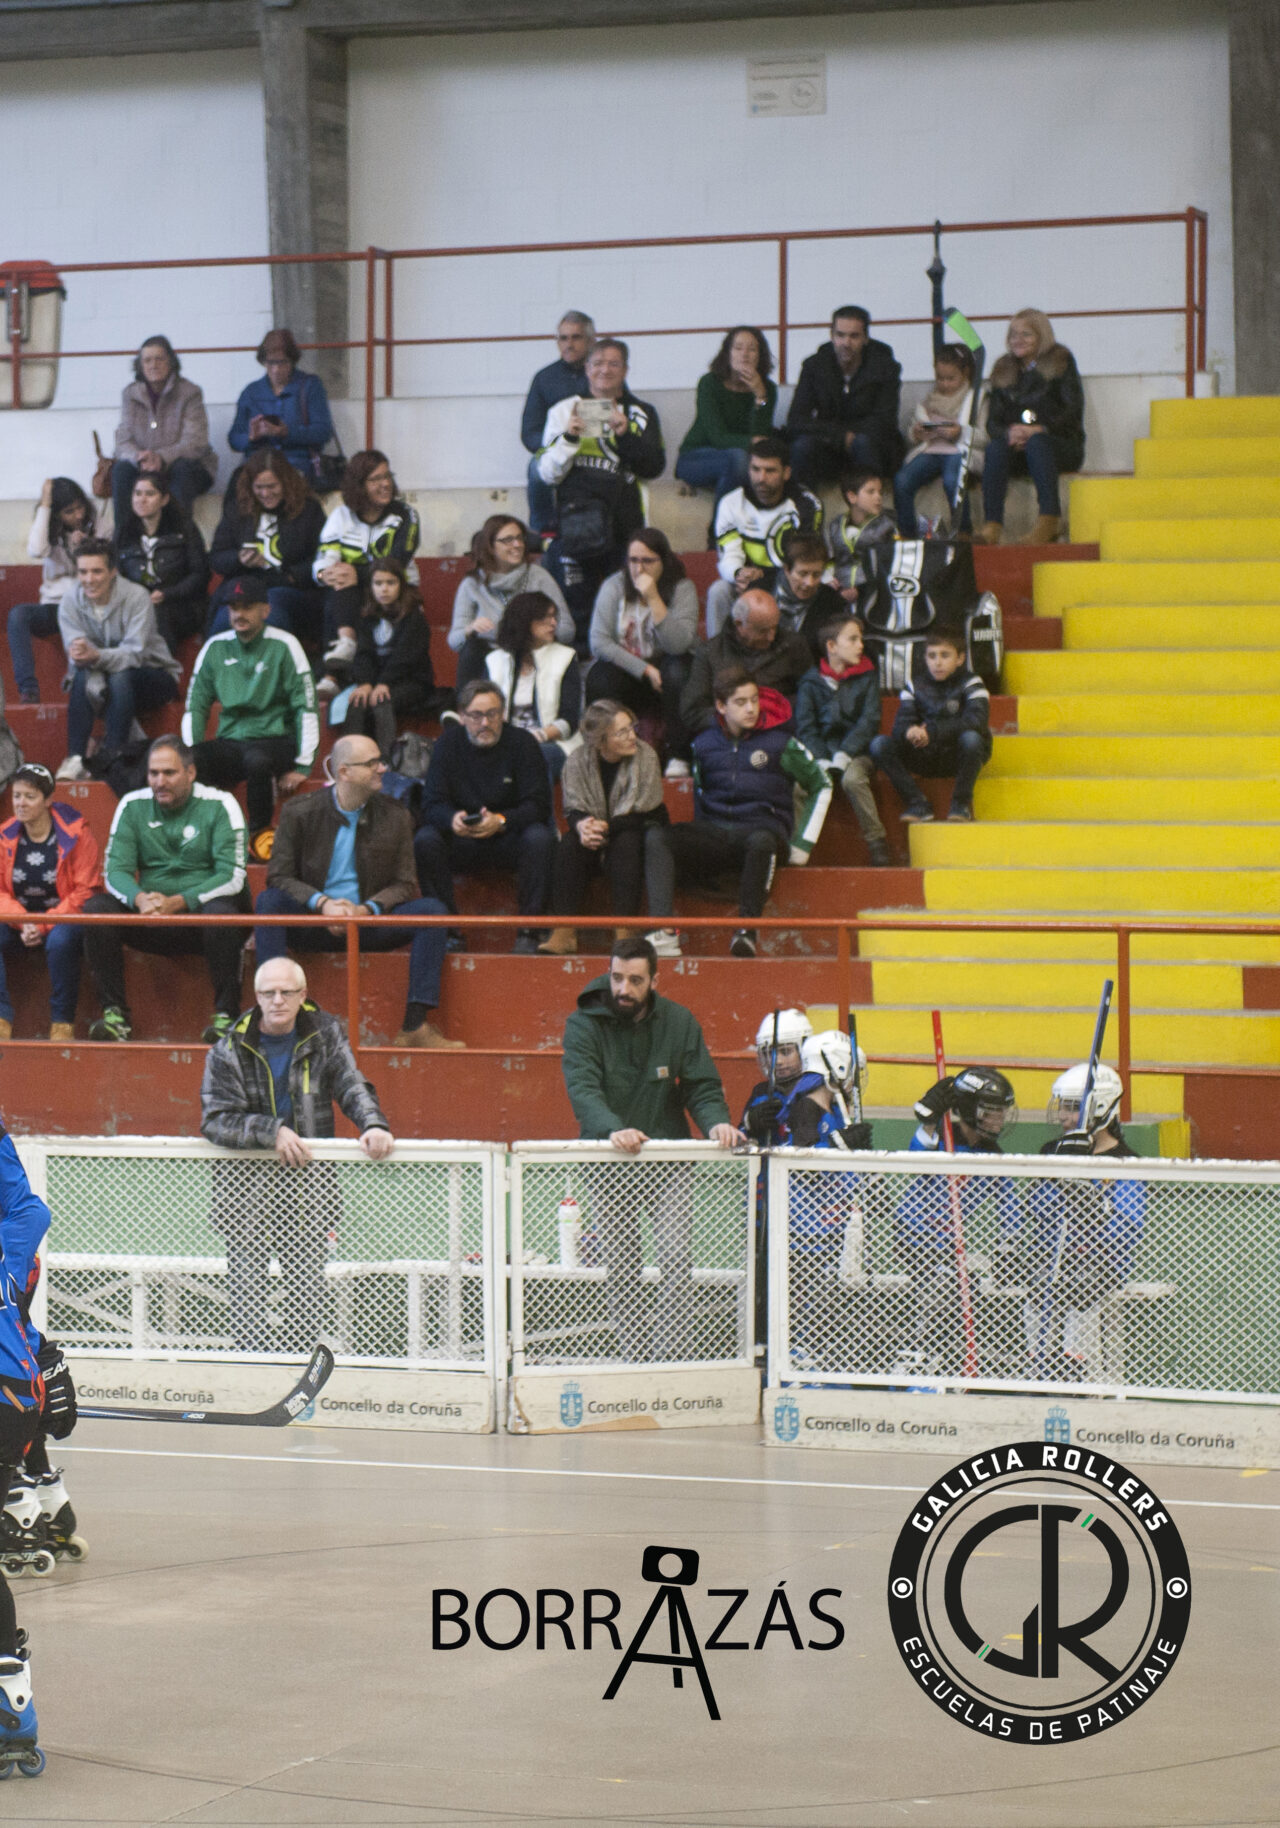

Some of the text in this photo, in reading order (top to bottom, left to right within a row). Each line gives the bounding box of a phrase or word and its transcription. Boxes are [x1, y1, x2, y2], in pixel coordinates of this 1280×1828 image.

[68, 786, 90, 799] 49
[673, 957, 699, 976] 42
[77, 1385, 215, 1404] Concello da Coruña
[587, 1394, 723, 1414] Concello da Coruña
[320, 1397, 382, 1413] Concello
[387, 1399, 404, 1414] da
[410, 1401, 462, 1417] Coruña
[804, 1416, 957, 1437] Concello da Coruña
[1075, 1428, 1235, 1449] Concello da Coruña
